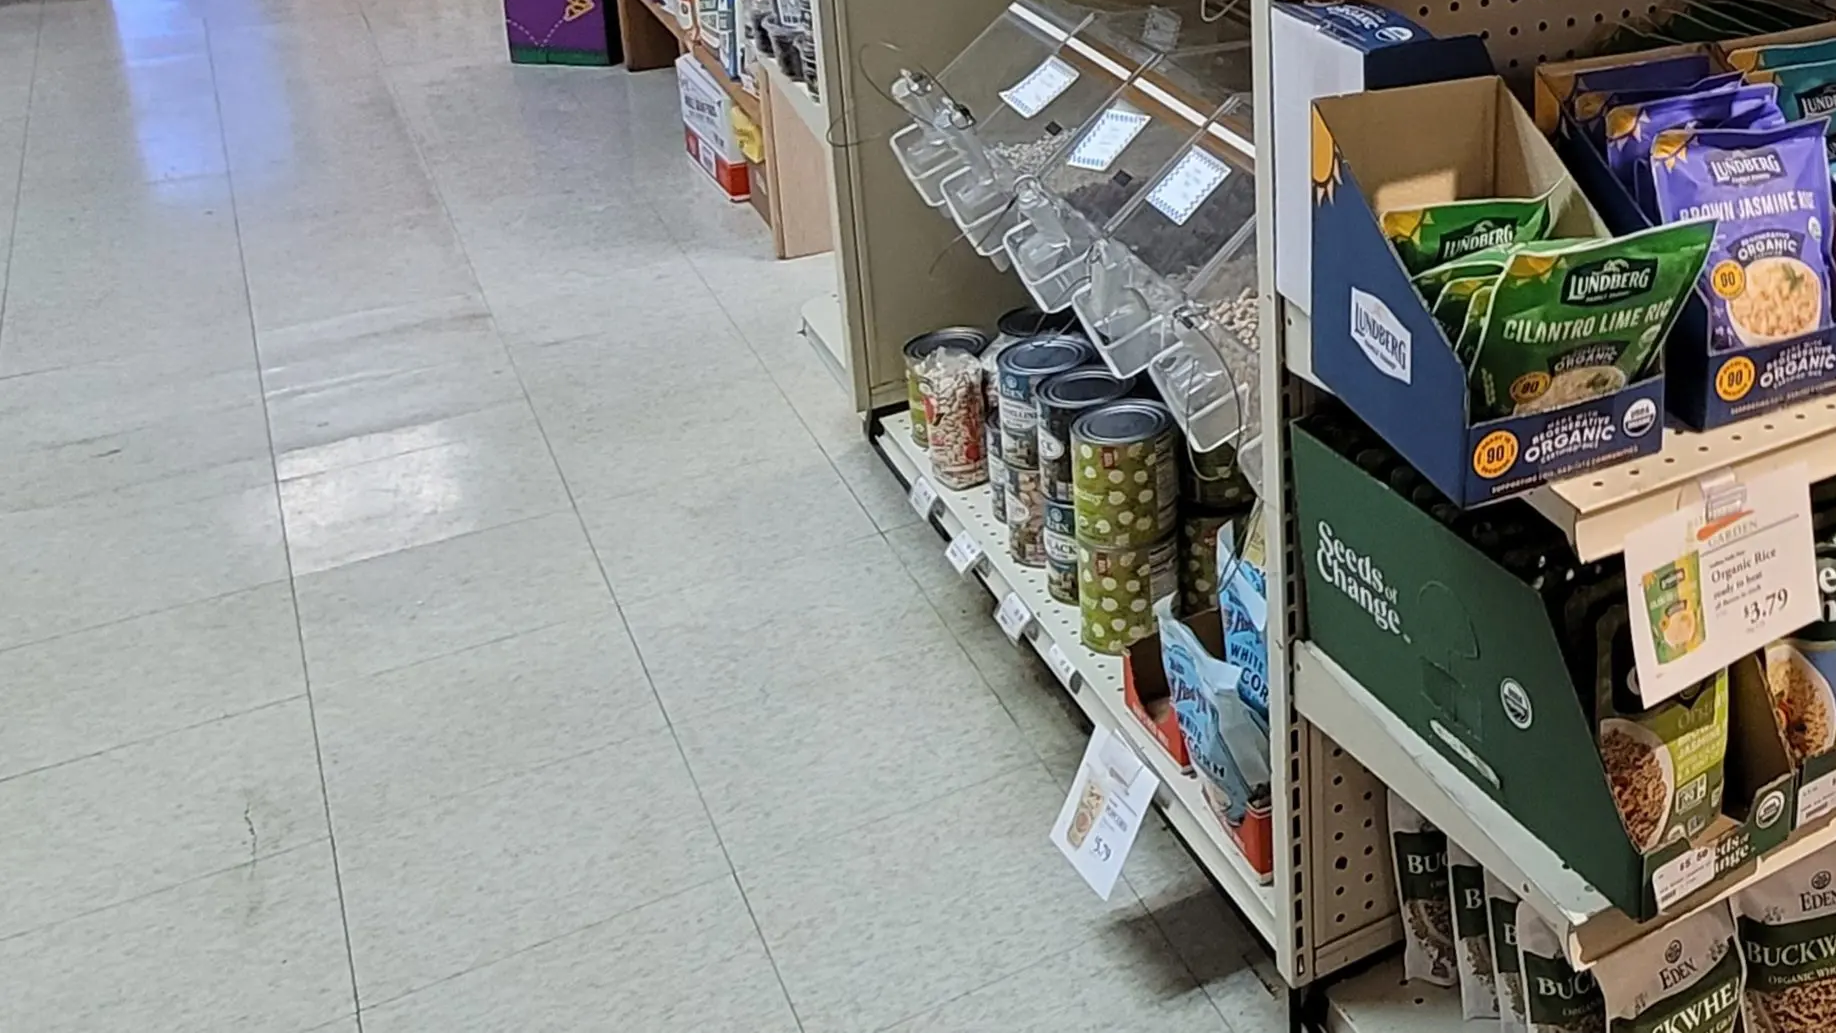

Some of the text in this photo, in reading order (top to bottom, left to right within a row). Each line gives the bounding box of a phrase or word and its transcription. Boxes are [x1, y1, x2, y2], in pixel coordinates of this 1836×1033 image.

[1710, 154, 1781, 183] LUNDBERG
[1738, 190, 1798, 219] JASMINE
[1443, 224, 1514, 258] LUNDBERG
[1738, 238, 1798, 260] ORGANIC
[1567, 267, 1651, 301] LUNDBERG
[1355, 302, 1406, 372] LUNDBERG
[1503, 297, 1674, 344] CILANTRO LIME RIC
[1759, 354, 1836, 389] ORGANIC
[1487, 445, 1505, 464] 90
[1524, 425, 1617, 463] ORGANIC
[1318, 520, 1398, 605] Seeds of
[1711, 559, 1752, 584] Organic
[1755, 547, 1777, 565] Rice
[1317, 548, 1401, 635] Change
[1713, 571, 1763, 600] ready to heat
[1743, 587, 1788, 624] $3.79
[1661, 959, 1698, 992] EDEN
[1768, 971, 1815, 985] ORGANIC
